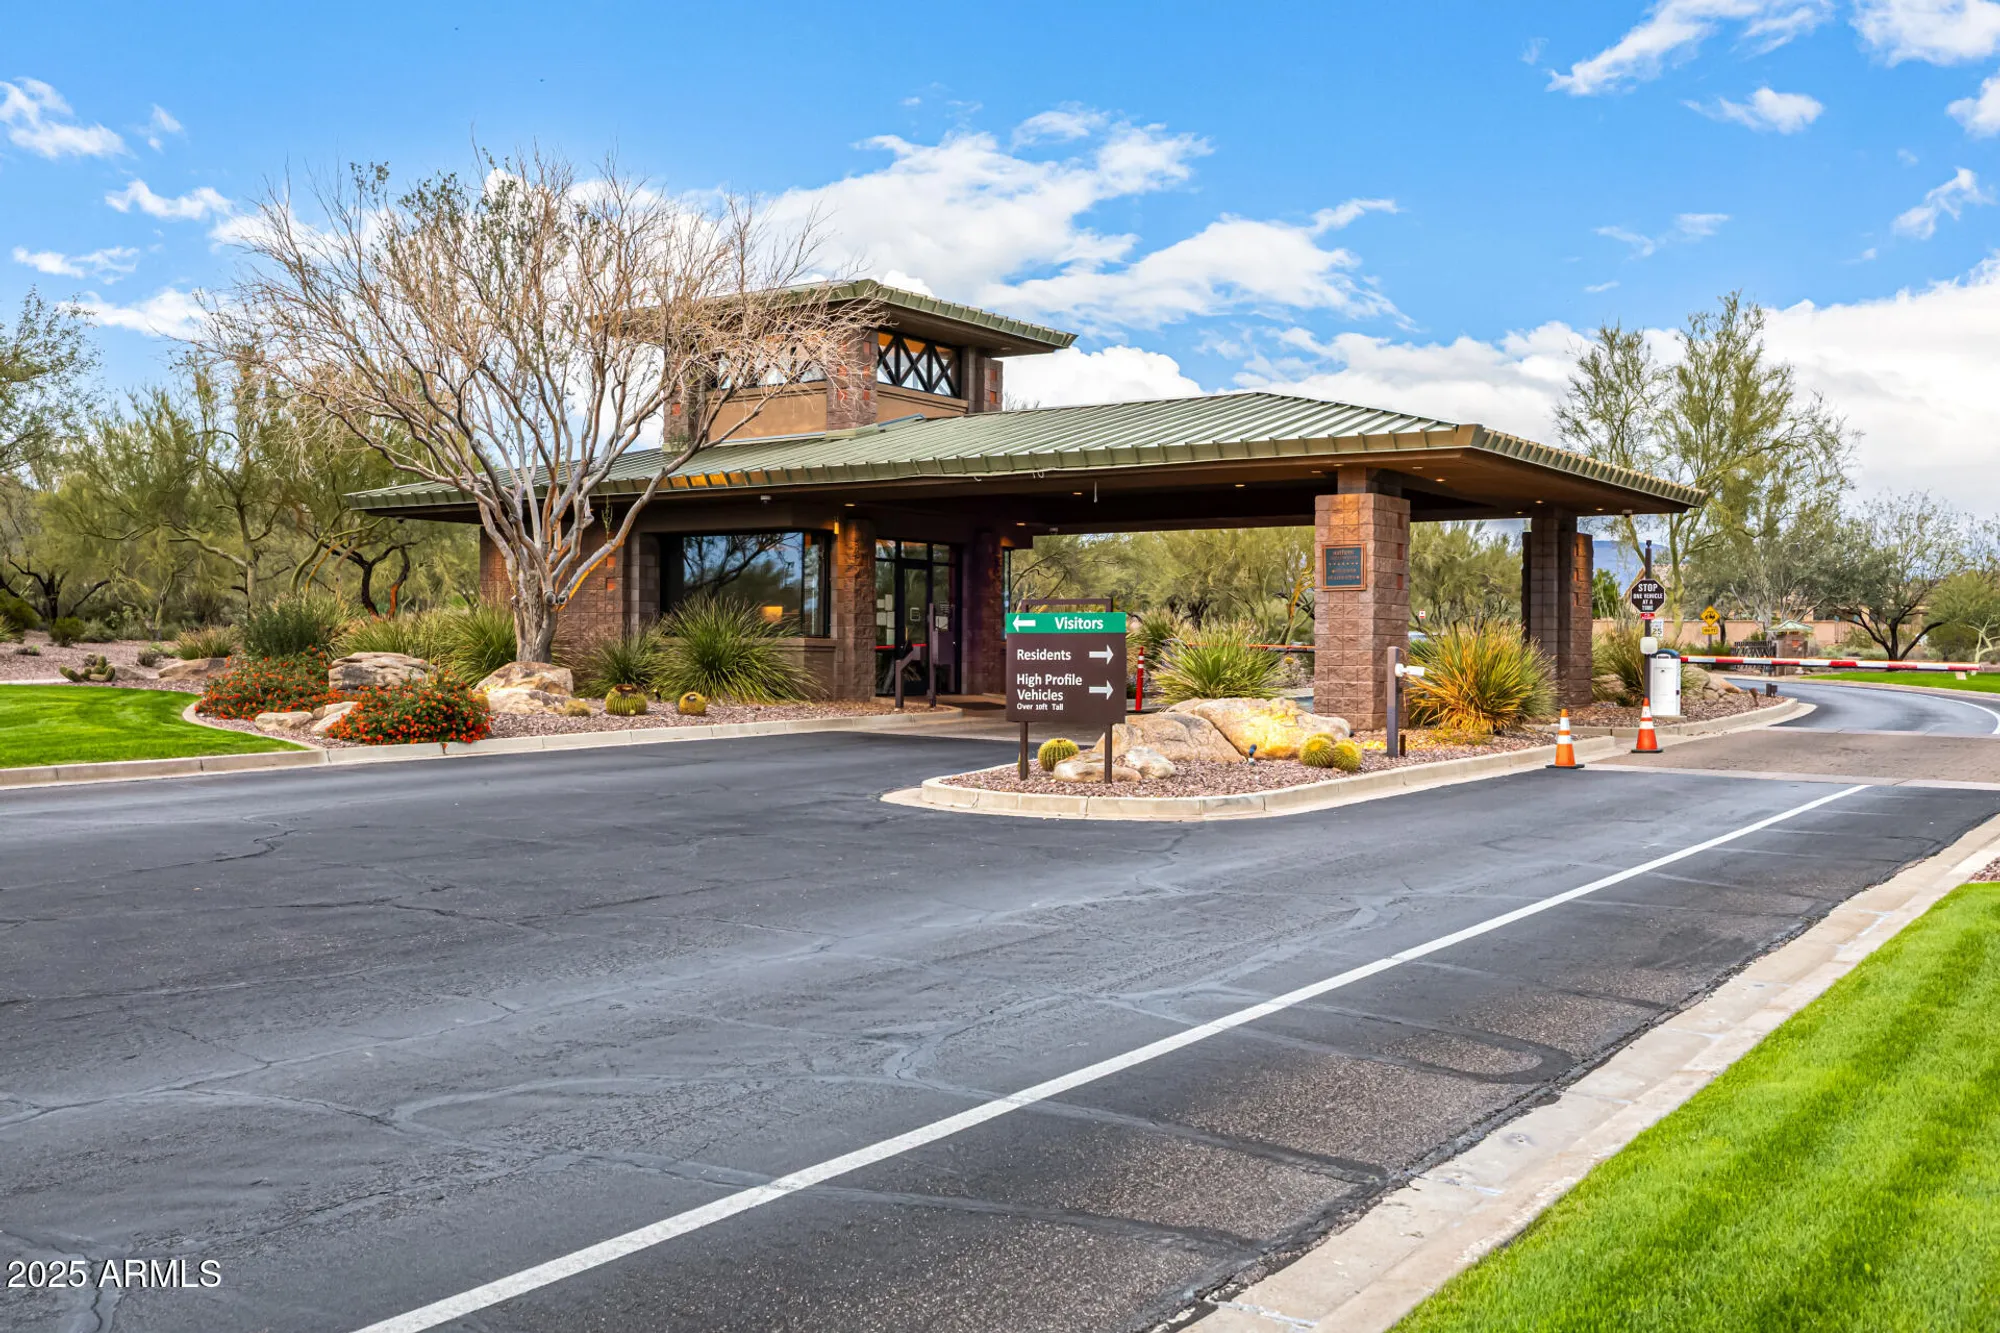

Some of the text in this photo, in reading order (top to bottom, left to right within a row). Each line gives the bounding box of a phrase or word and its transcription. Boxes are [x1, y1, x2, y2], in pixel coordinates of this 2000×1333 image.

[1638, 584, 1658, 592] STOP
[1054, 616, 1104, 630] Visitors
[1016, 649, 1072, 661] Residents
[1016, 673, 1083, 688] High Profile
[1017, 688, 1064, 701] Vehicles
[1035, 703, 1048, 711] 10ft
